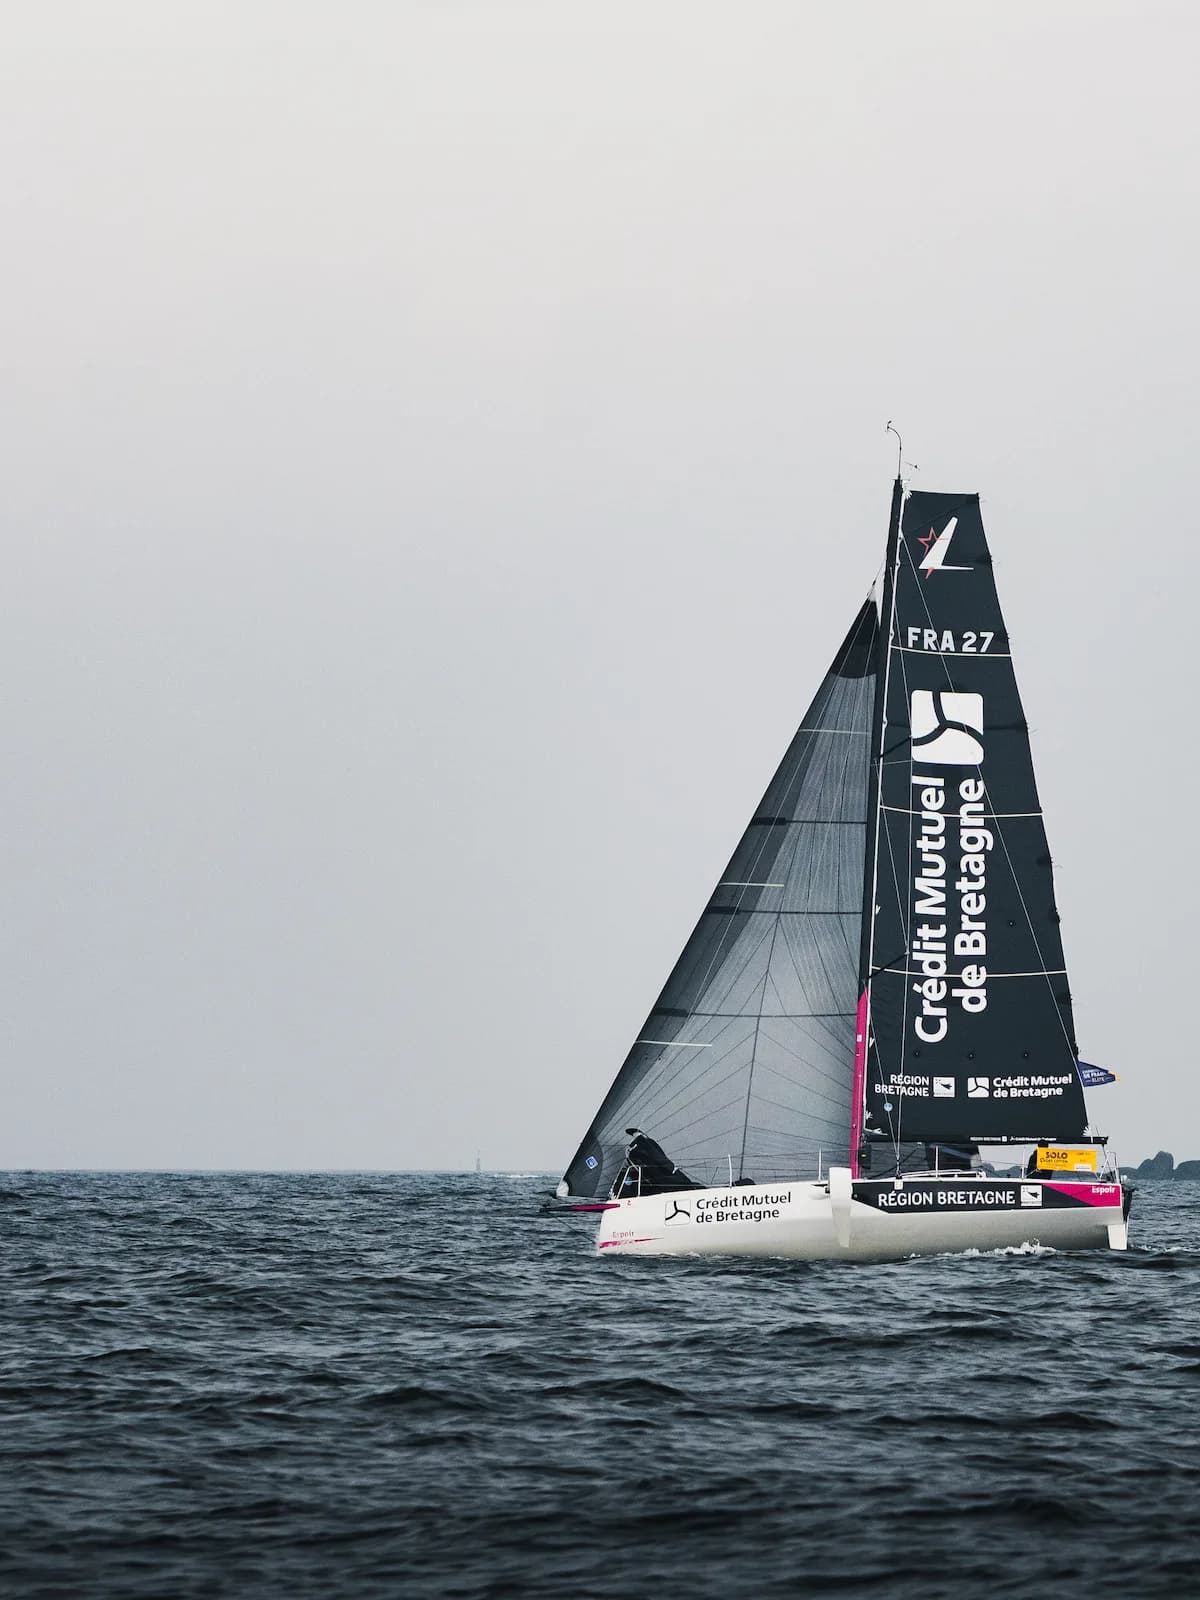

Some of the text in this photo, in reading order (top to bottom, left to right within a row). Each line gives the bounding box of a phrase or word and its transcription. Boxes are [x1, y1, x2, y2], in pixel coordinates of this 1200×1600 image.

[907, 626, 994, 653] FRA 27
[951, 778, 994, 1013] de Bretagne
[911, 776, 948, 1043] Crédit Mutuel
[890, 1073, 929, 1086] RÉGION
[993, 1073, 1073, 1088] Crédit Mutuel
[874, 1083, 930, 1097] BRETAGNE
[993, 1086, 1063, 1098] de Bretagne
[1045, 1151, 1069, 1160] SOLO
[878, 1190, 1016, 1207] RÉGION BRETAGNE
[1092, 1186, 1116, 1196] Espoir
[696, 1191, 792, 1210] Crédit Mutuel
[696, 1207, 780, 1224] de Bretagne
